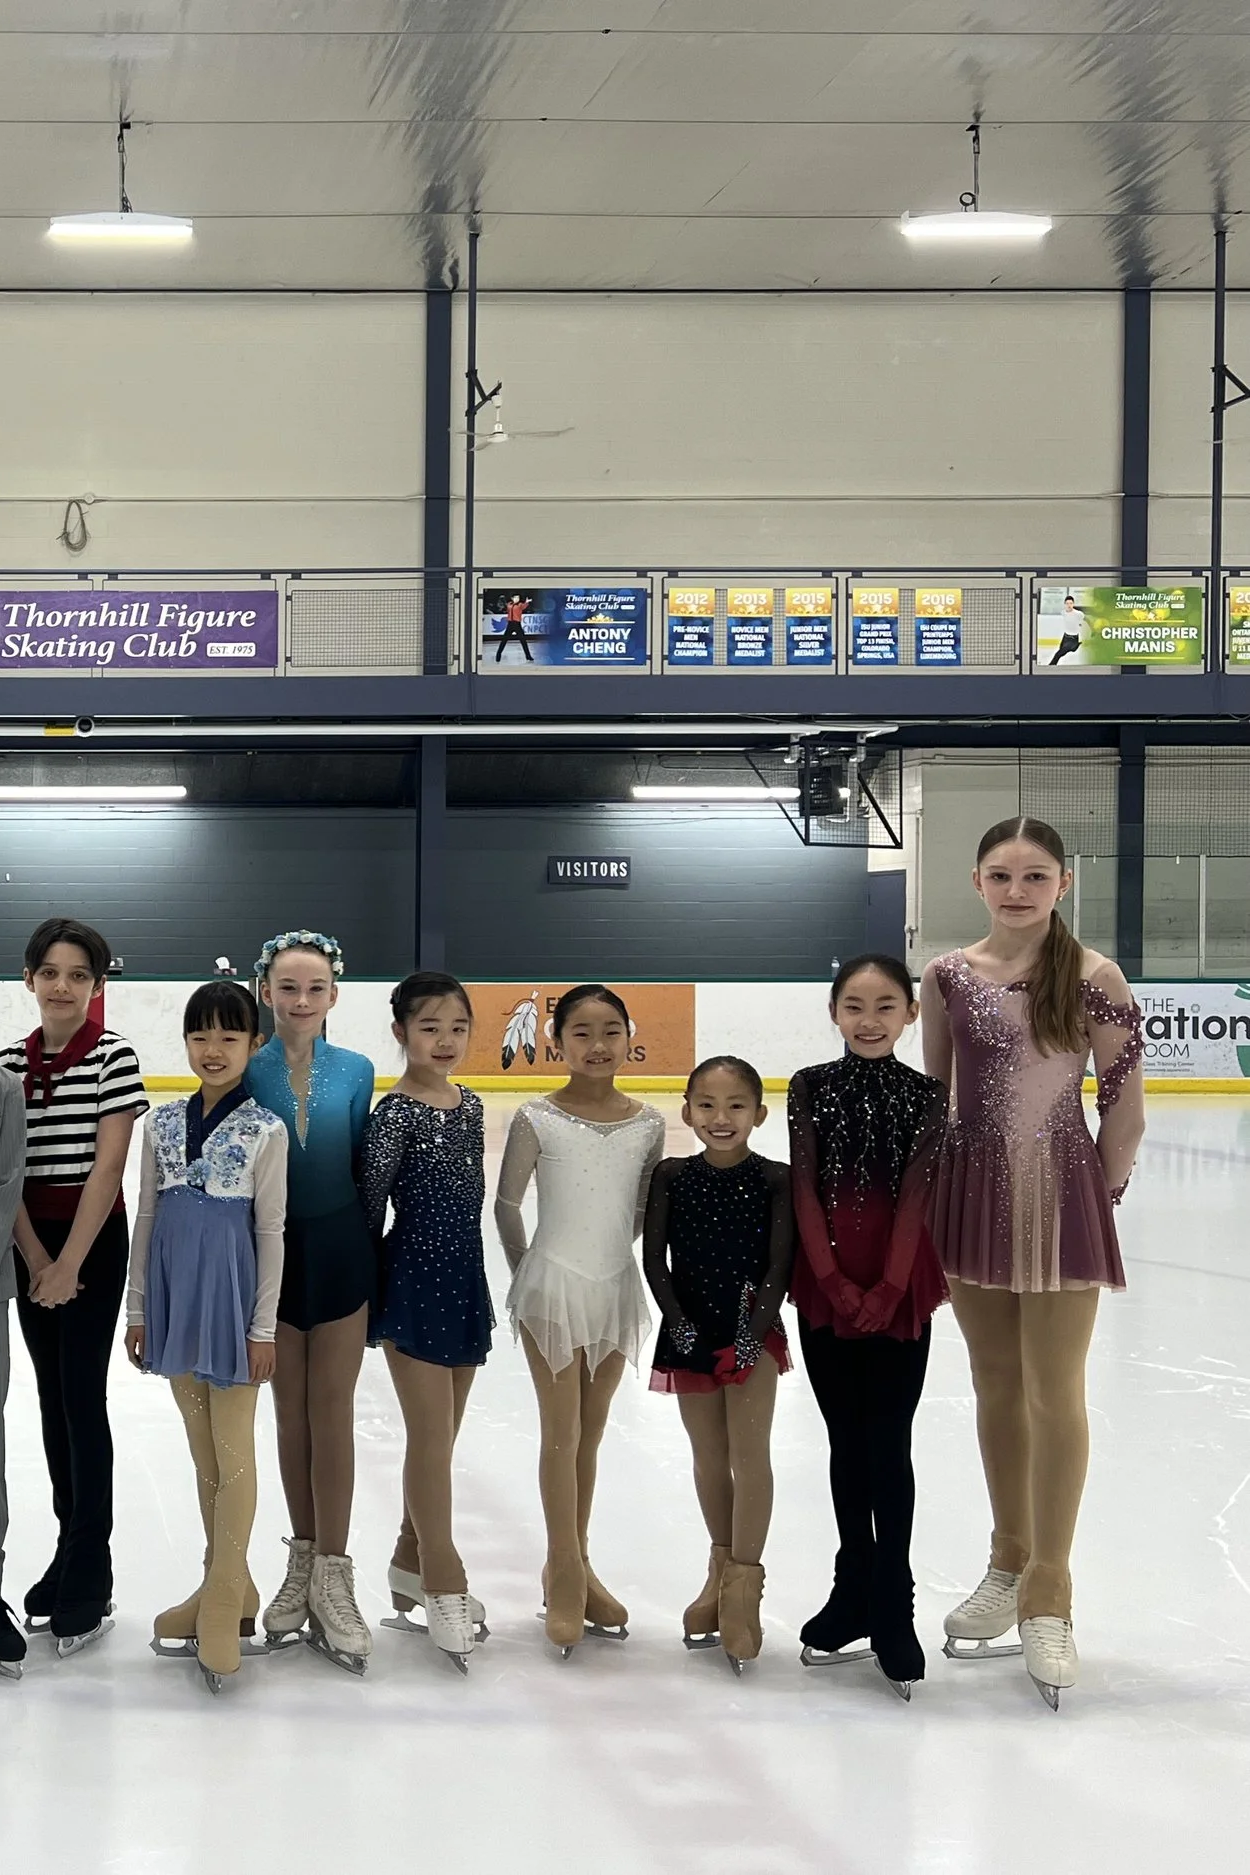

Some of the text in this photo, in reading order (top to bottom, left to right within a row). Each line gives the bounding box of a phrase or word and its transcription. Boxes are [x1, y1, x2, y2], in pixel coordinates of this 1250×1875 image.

[565, 594, 636, 604] Thornhill Figure
[675, 593, 708, 604] 2012
[734, 593, 767, 605] 2013
[792, 593, 825, 604] 2015
[859, 593, 892, 604] 2015
[921, 594, 955, 605] 2016
[1116, 593, 1185, 603] Thornhill Figure
[565, 602, 597, 611] Skating
[598, 602, 619, 610] Club
[1115, 601, 1147, 610] Skating
[1148, 601, 1169, 609] Club
[3, 602, 257, 635] Thornhill Figure
[568, 628, 631, 640] ANTONY
[673, 626, 710, 634] PRE-NOVICE
[731, 626, 753, 634] NOVICE
[790, 626, 813, 634] JUNIOR
[1102, 627, 1198, 639] CHRISTOPHER
[1, 632, 197, 665] Skating Club
[209, 645, 254, 655] EST. 1975
[573, 642, 626, 654] CHENG
[676, 641, 706, 649] NATIONAL
[1125, 641, 1175, 653] MANIS
[674, 649, 708, 657] CHAMPION
[794, 649, 824, 657] MEDALIST
[556, 861, 628, 877] VISITORS
[1142, 998, 1175, 1012] THE
[1141, 1003, 1250, 1040] ation
[1143, 1043, 1190, 1058] OOM
